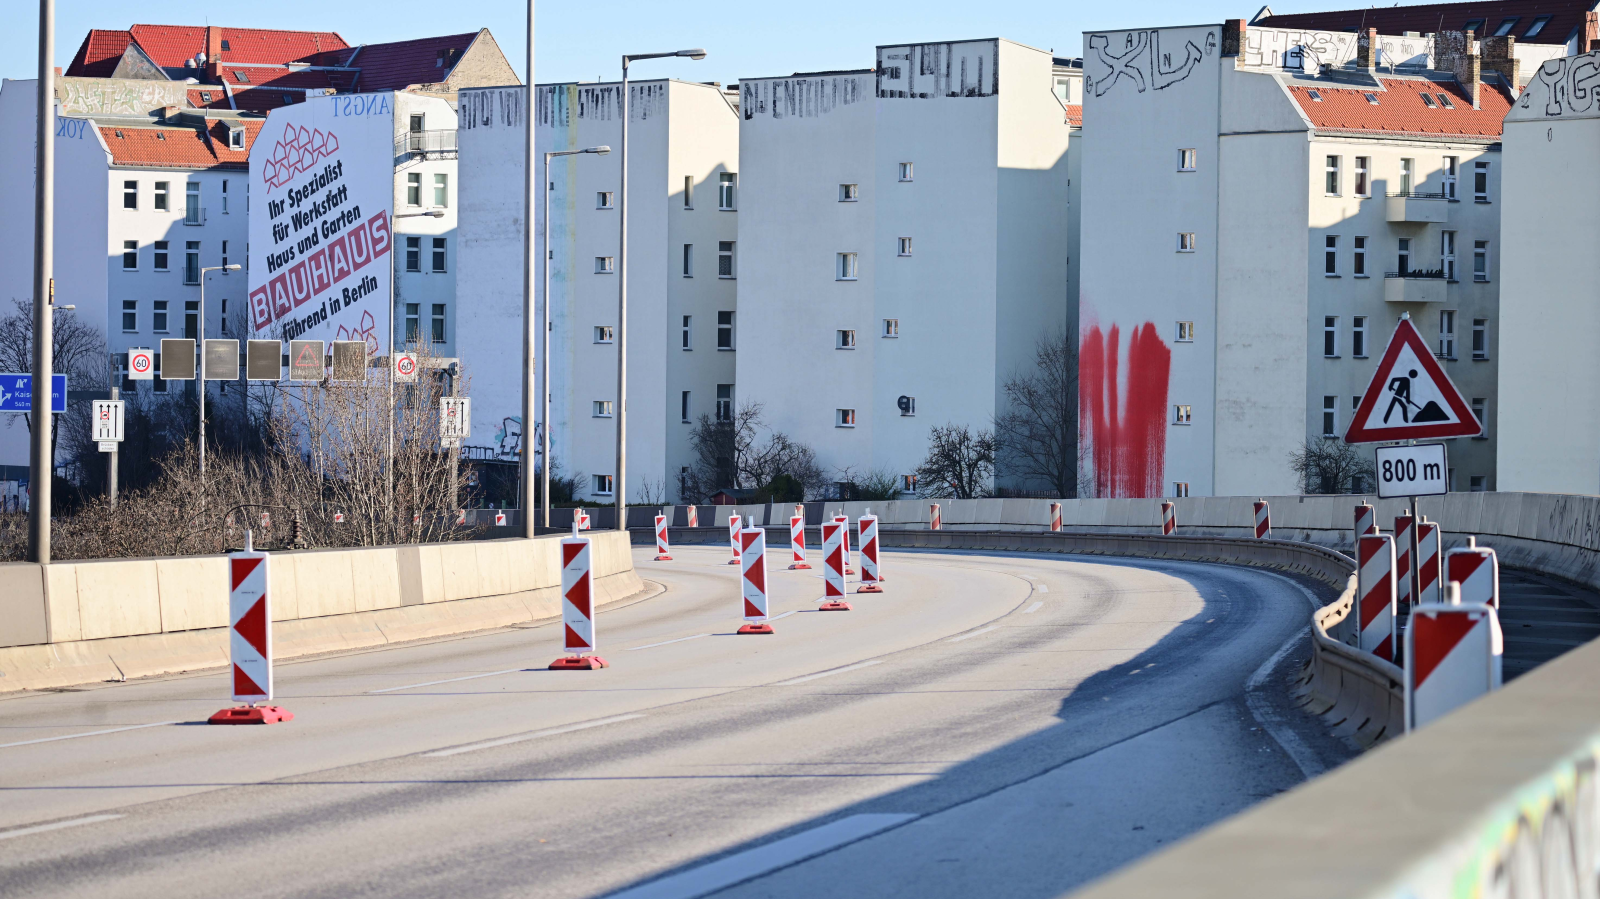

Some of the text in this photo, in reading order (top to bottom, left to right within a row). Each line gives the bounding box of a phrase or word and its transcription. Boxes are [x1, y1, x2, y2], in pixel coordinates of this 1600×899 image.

[268, 159, 343, 220] Ihr Spezialist
[272, 183, 348, 245] für Werkstatt
[266, 205, 361, 274] Haus und Garten
[251, 214, 390, 329] BAUHAUS
[281, 275, 378, 344] führend in Berlin
[136, 359, 147, 368] 60
[1382, 458, 1441, 482] 800 m
